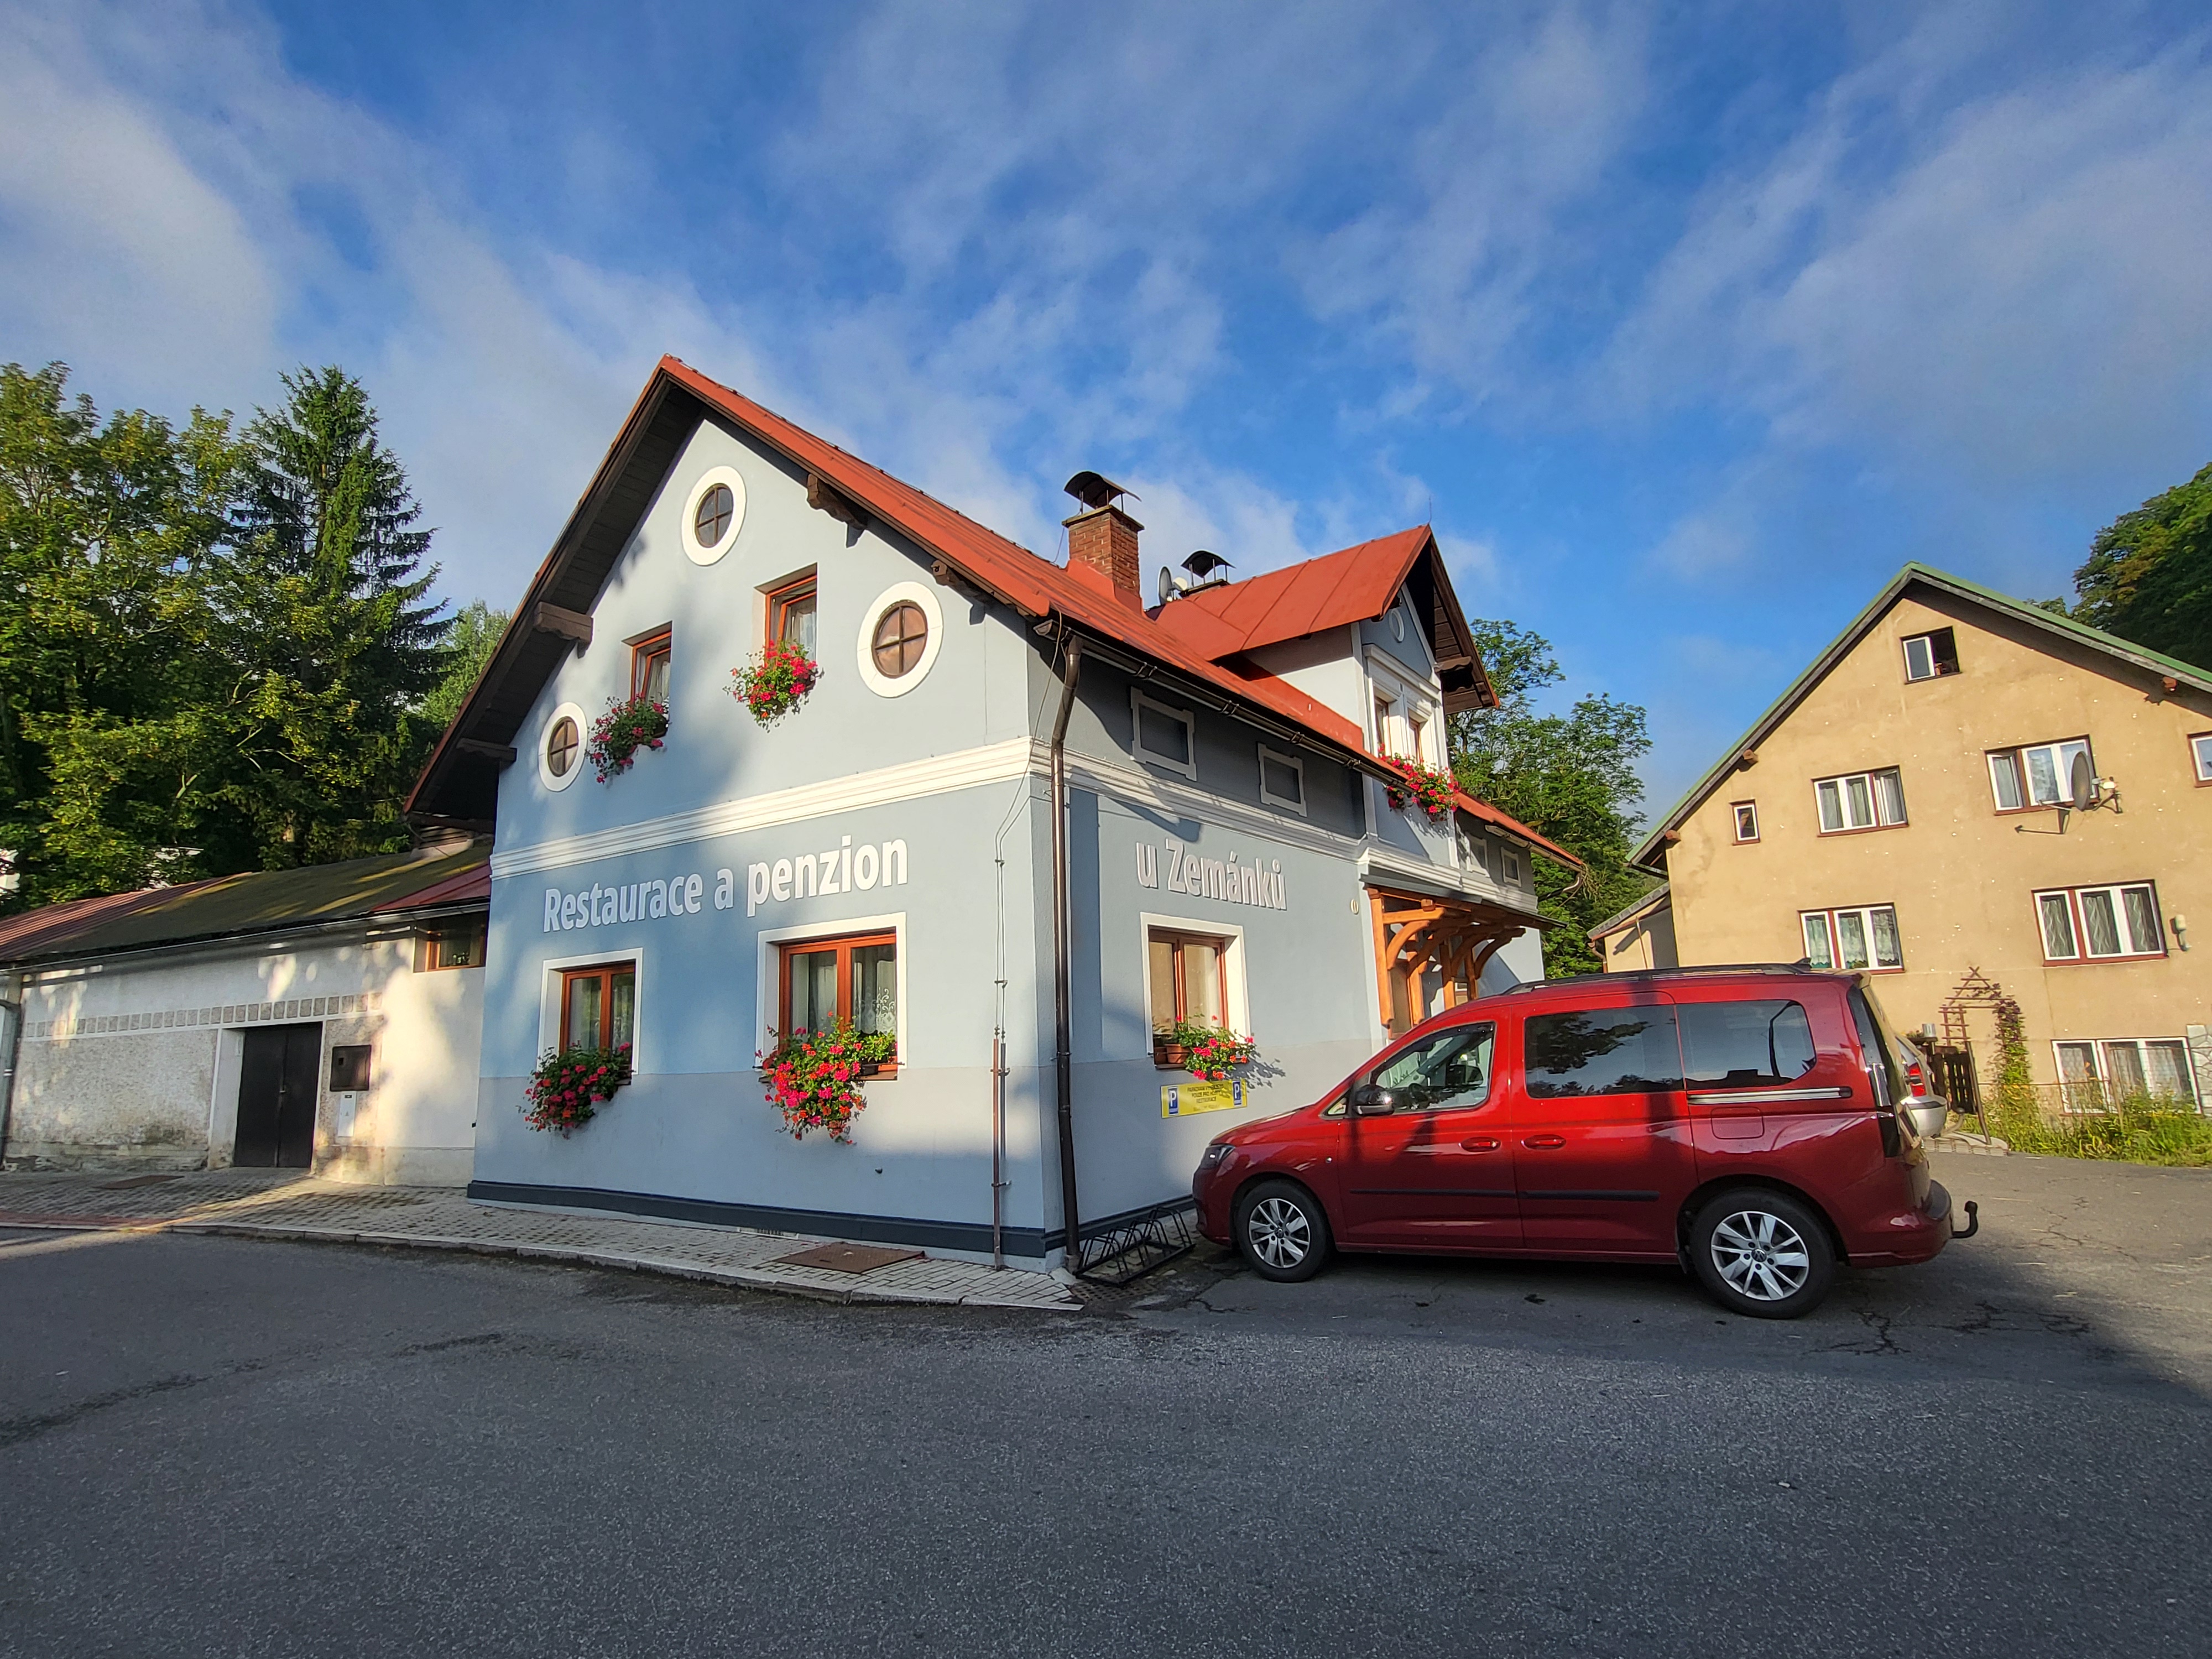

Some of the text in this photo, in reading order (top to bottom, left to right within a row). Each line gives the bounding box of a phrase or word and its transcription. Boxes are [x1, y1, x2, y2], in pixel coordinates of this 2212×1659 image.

[543, 835, 908, 932] Restaurace a penzion
[1136, 838, 1287, 911] u Zemánků
[1169, 1090, 1177, 1107] P
[1234, 1083, 1240, 1099] P
